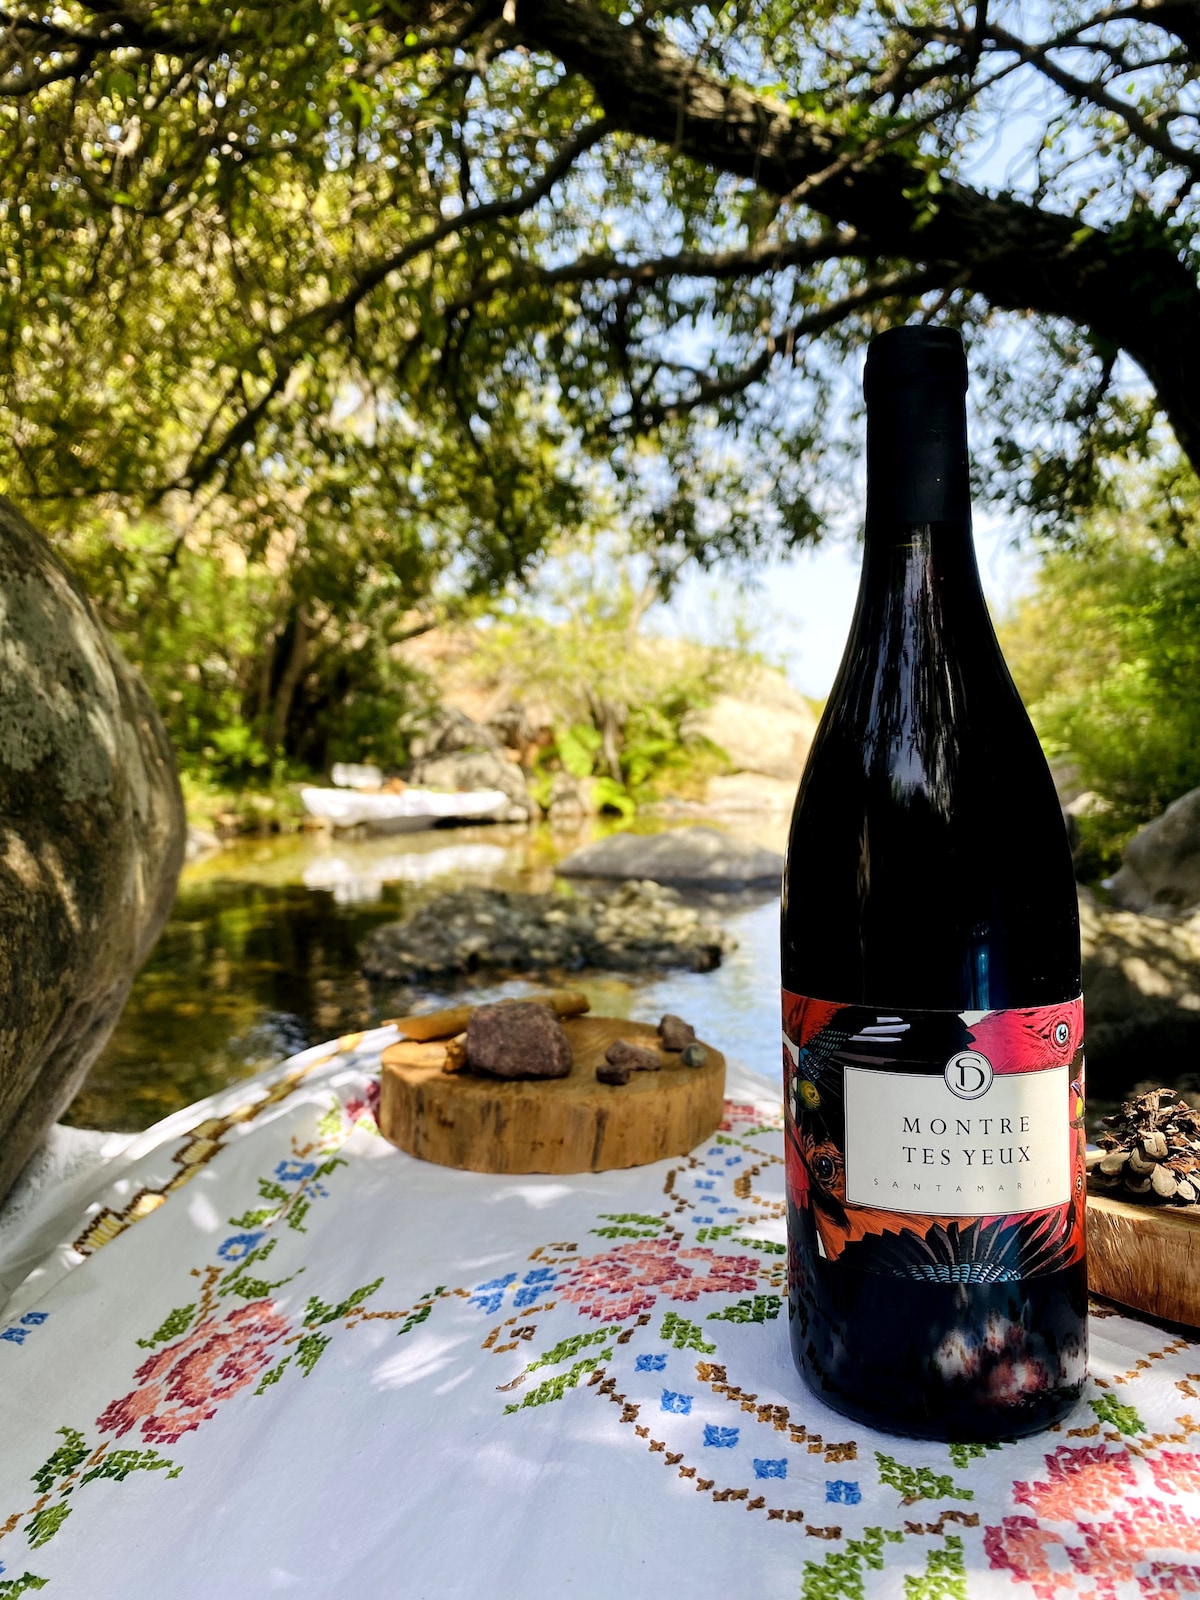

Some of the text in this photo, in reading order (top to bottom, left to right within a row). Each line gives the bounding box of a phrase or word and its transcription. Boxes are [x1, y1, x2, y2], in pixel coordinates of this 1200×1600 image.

[902, 1116, 1030, 1135] MONTRE
[902, 1146, 1031, 1166] TES YEUX
[873, 1177, 1052, 1193] SANTAMARIA
